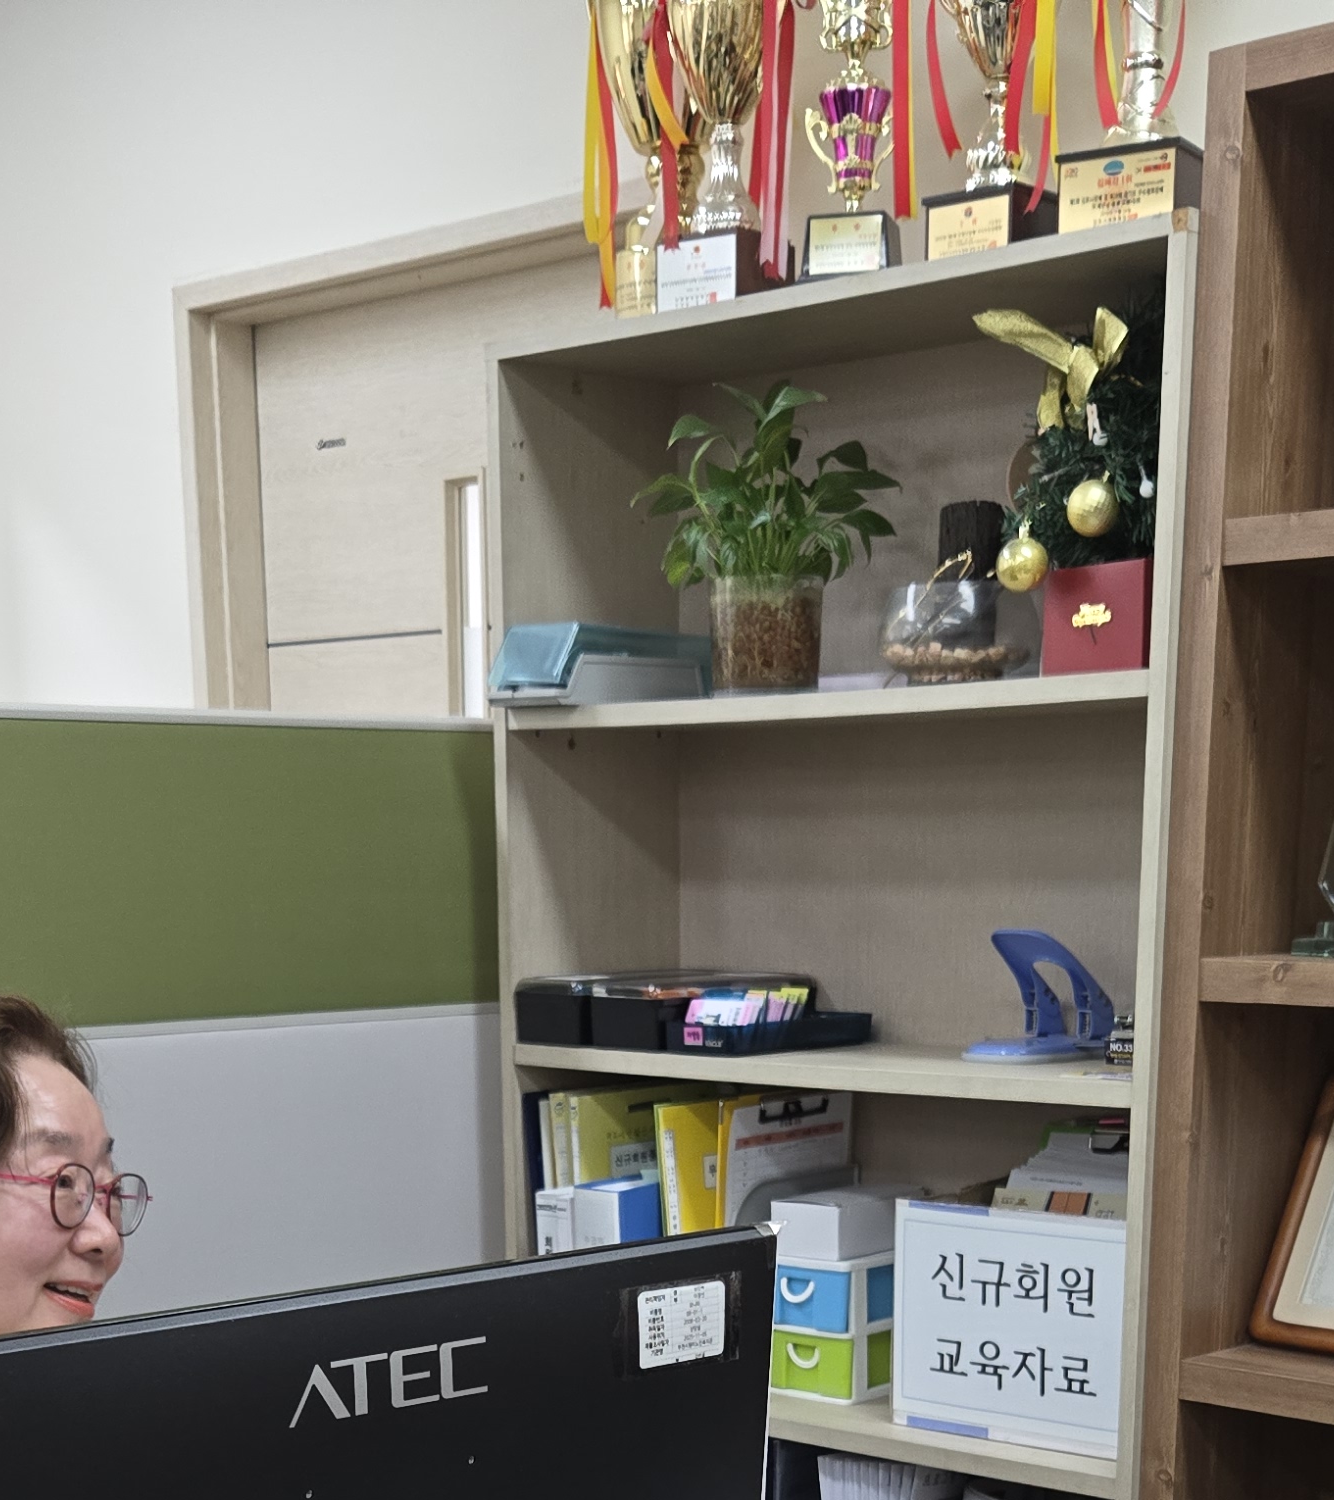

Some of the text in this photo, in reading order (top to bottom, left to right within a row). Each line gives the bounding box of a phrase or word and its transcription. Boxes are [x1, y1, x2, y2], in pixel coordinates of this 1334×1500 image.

[931, 1252, 1096, 1318] 신규회원
[289, 1336, 489, 1429] ATEC
[929, 1338, 1098, 1397] 교육자료
